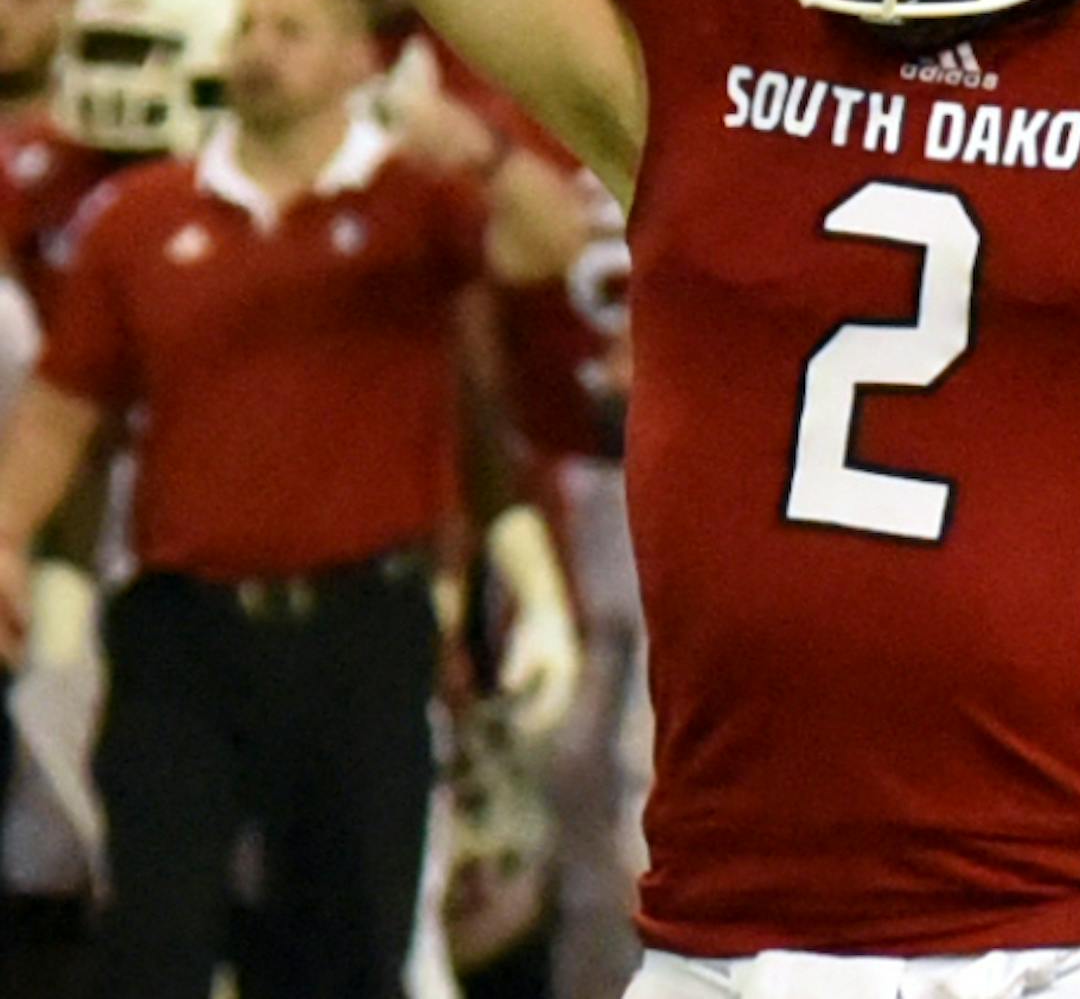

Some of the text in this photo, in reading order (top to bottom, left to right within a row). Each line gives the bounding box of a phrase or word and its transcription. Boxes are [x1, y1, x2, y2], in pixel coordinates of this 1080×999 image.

[724, 64, 906, 154] SOUTH
[901, 61, 998, 90] adidas
[784, 179, 984, 543] 2
